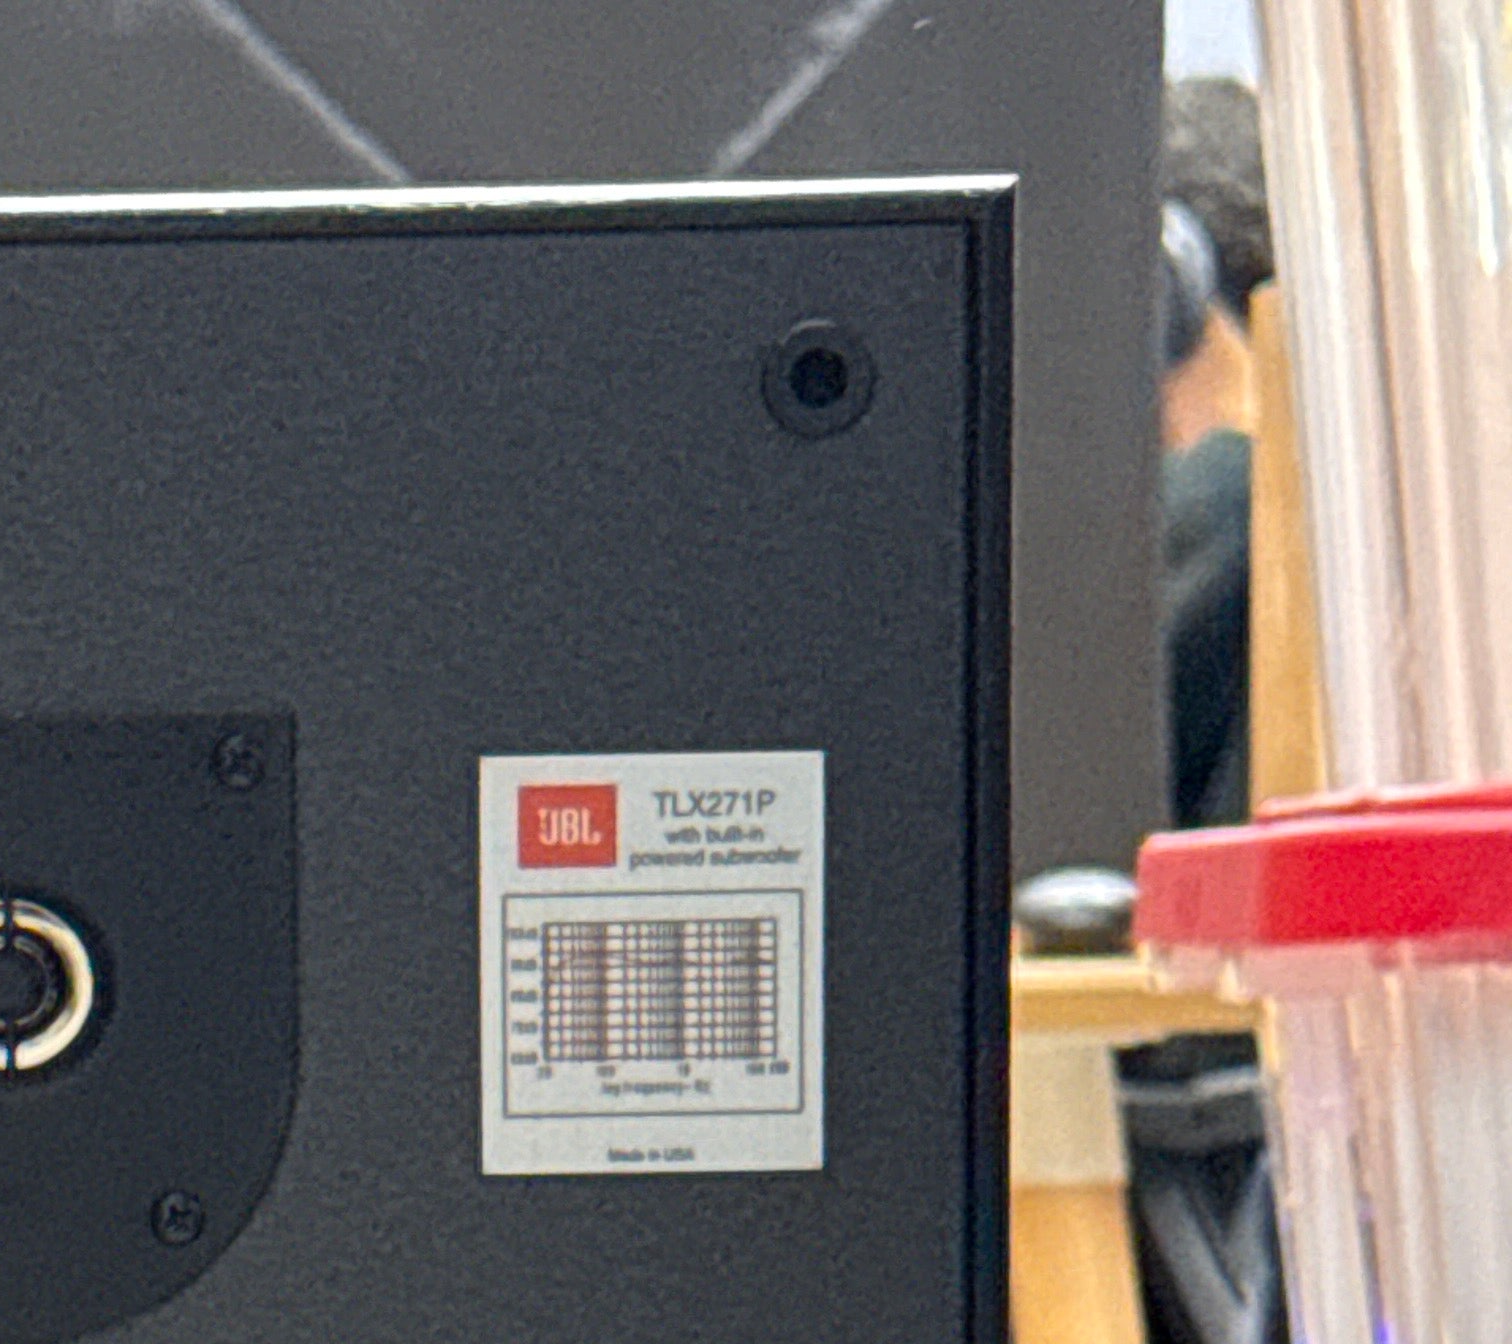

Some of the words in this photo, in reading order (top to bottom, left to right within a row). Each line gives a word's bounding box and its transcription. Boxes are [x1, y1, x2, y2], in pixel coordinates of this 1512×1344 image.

[651, 789, 777, 818] TLX271P
[538, 806, 602, 846] JBL
[664, 825, 701, 844] with
[706, 823, 765, 844] built-in
[628, 848, 705, 872] powered
